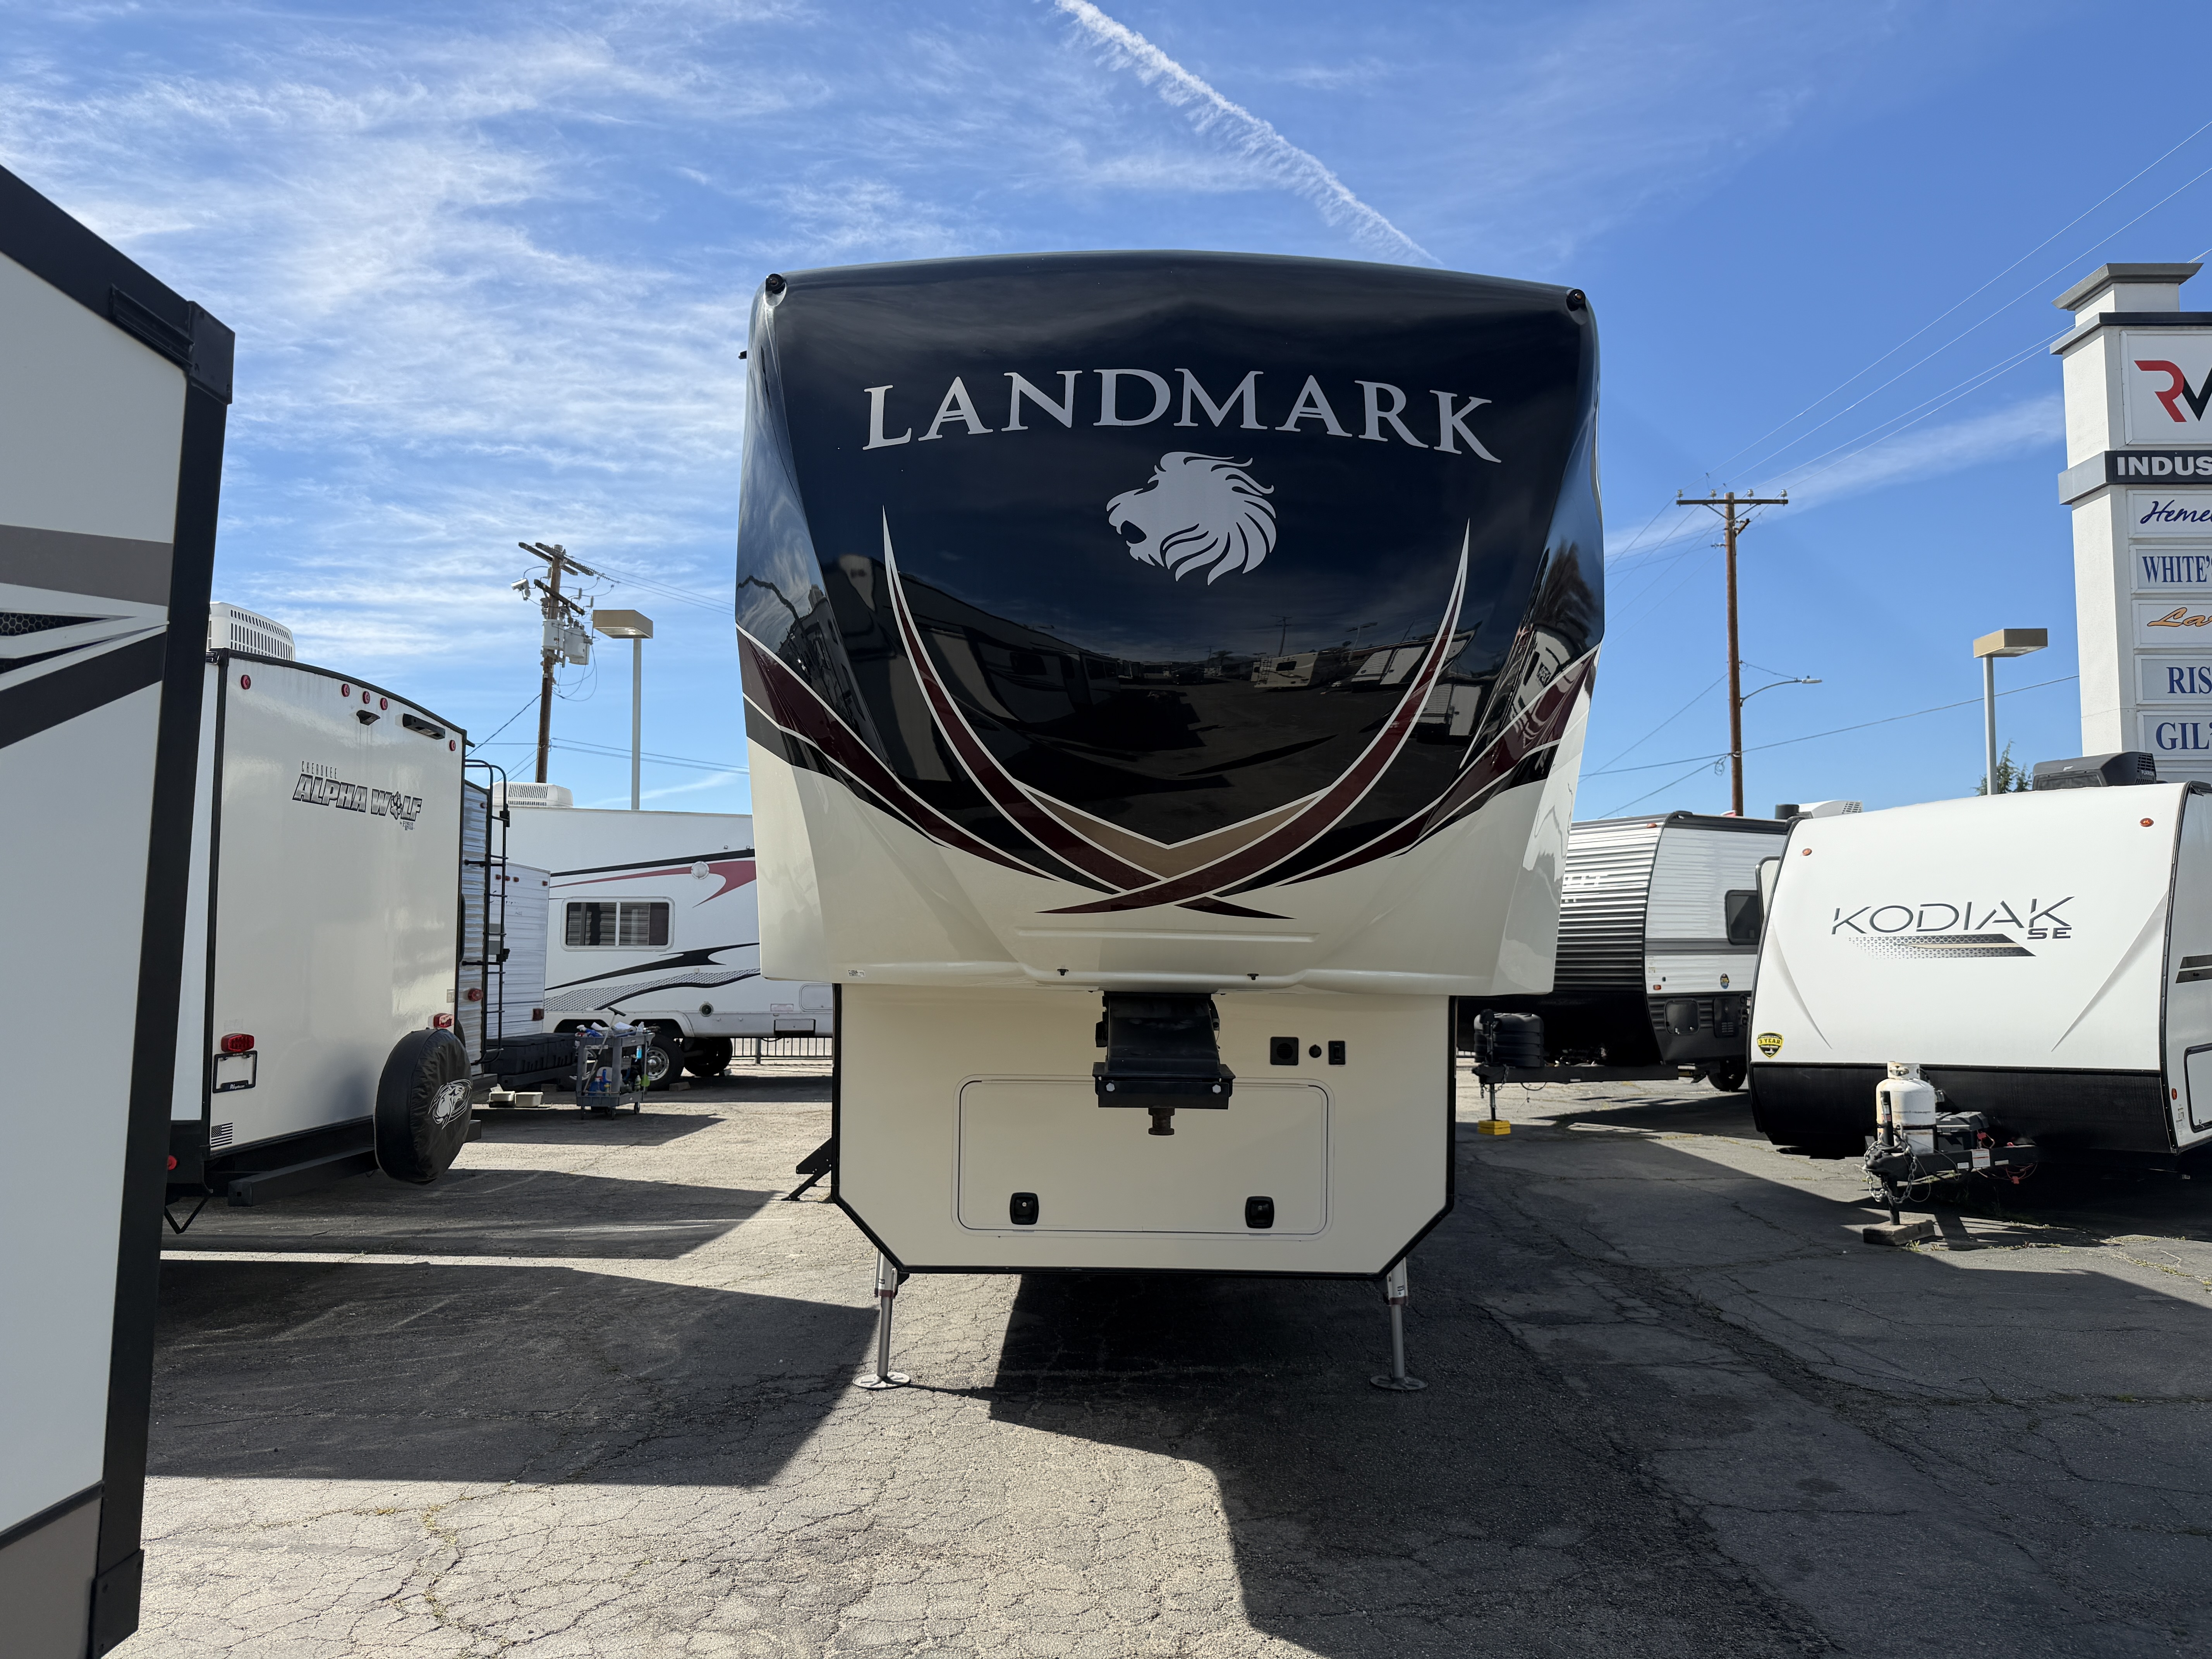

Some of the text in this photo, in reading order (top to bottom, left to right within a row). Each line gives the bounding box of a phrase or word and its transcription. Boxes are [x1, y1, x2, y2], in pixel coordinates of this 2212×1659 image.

[863, 368, 1501, 463] LANDMARK
[2140, 500, 2212, 524] Heme
[2142, 555, 2212, 583] WHITE'
[2147, 607, 2212, 627] La
[2166, 666, 2212, 694] RIS
[292, 773, 368, 813] ALPHA
[1831, 896, 2075, 935] KODIAK
[2027, 927, 2072, 940] SE
